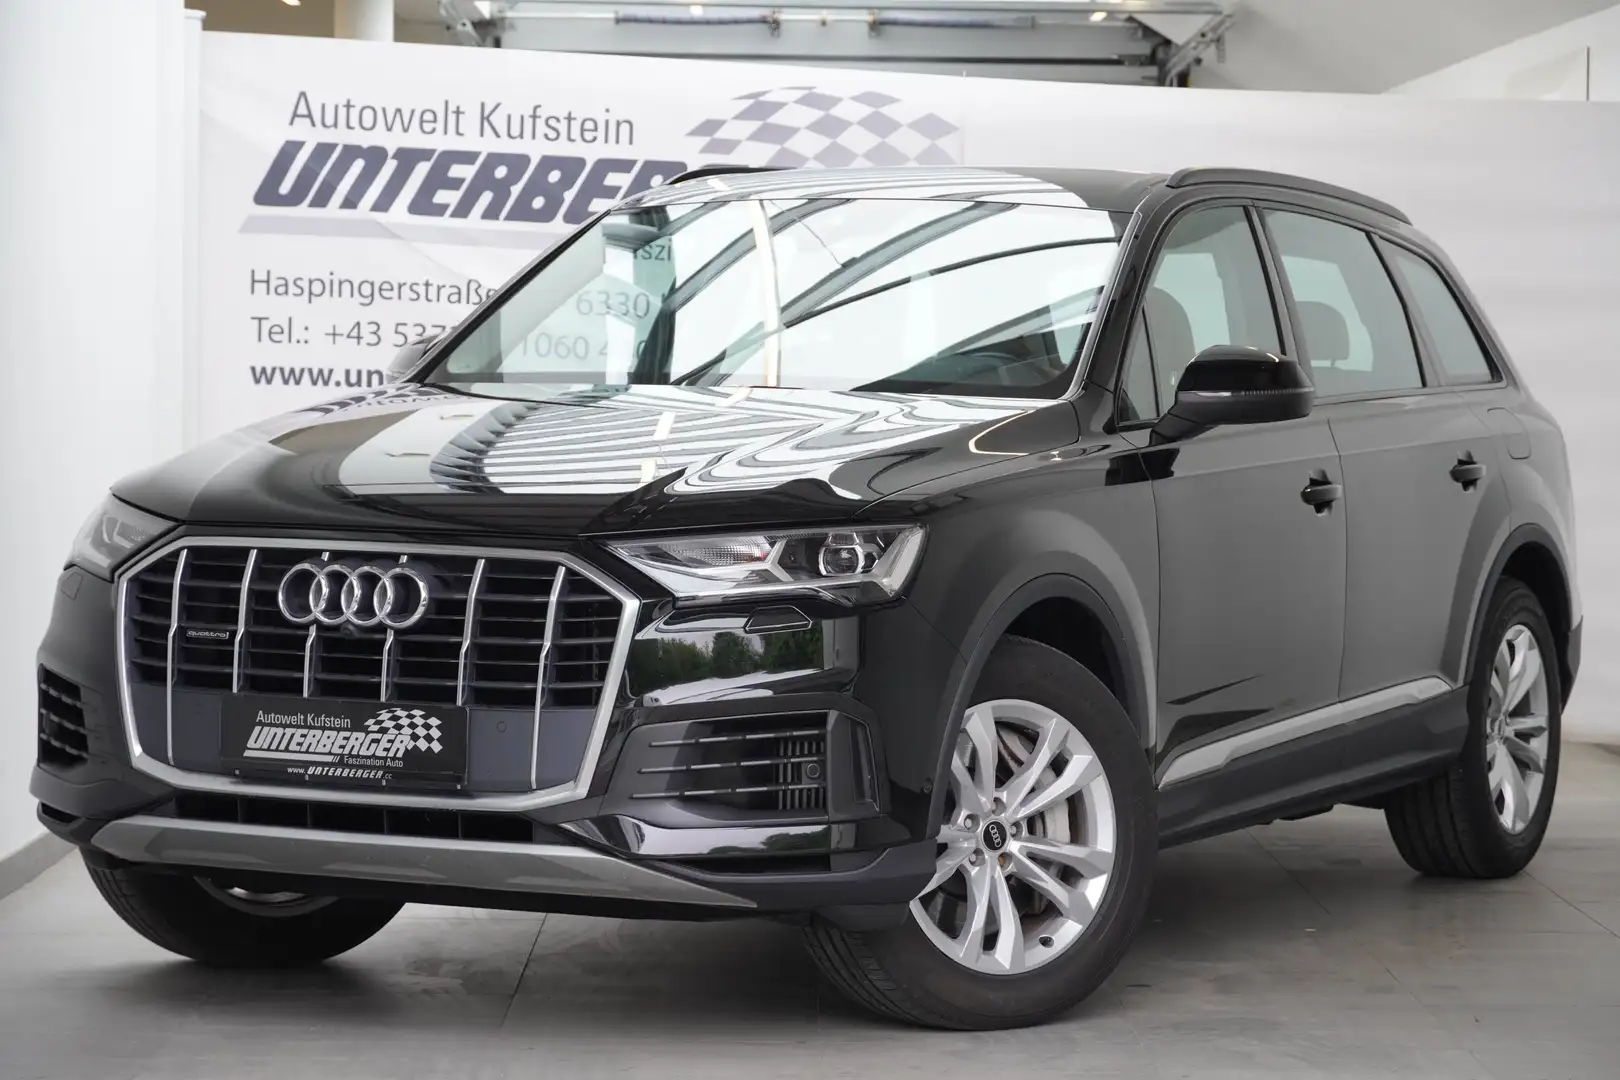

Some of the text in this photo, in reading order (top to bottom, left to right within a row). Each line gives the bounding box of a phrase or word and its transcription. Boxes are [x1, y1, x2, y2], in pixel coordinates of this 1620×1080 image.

[288, 91, 635, 146] Autowelt Kufstein
[576, 289, 651, 319] 6330
[250, 316, 310, 345] Tel.:
[324, 320, 383, 347] +43
[187, 629, 228, 639] quattro
[256, 710, 351, 729] Autowelt Kufstein
[246, 725, 411, 758] UNTERBERGER
[343, 755, 404, 768] Faszination Auto
